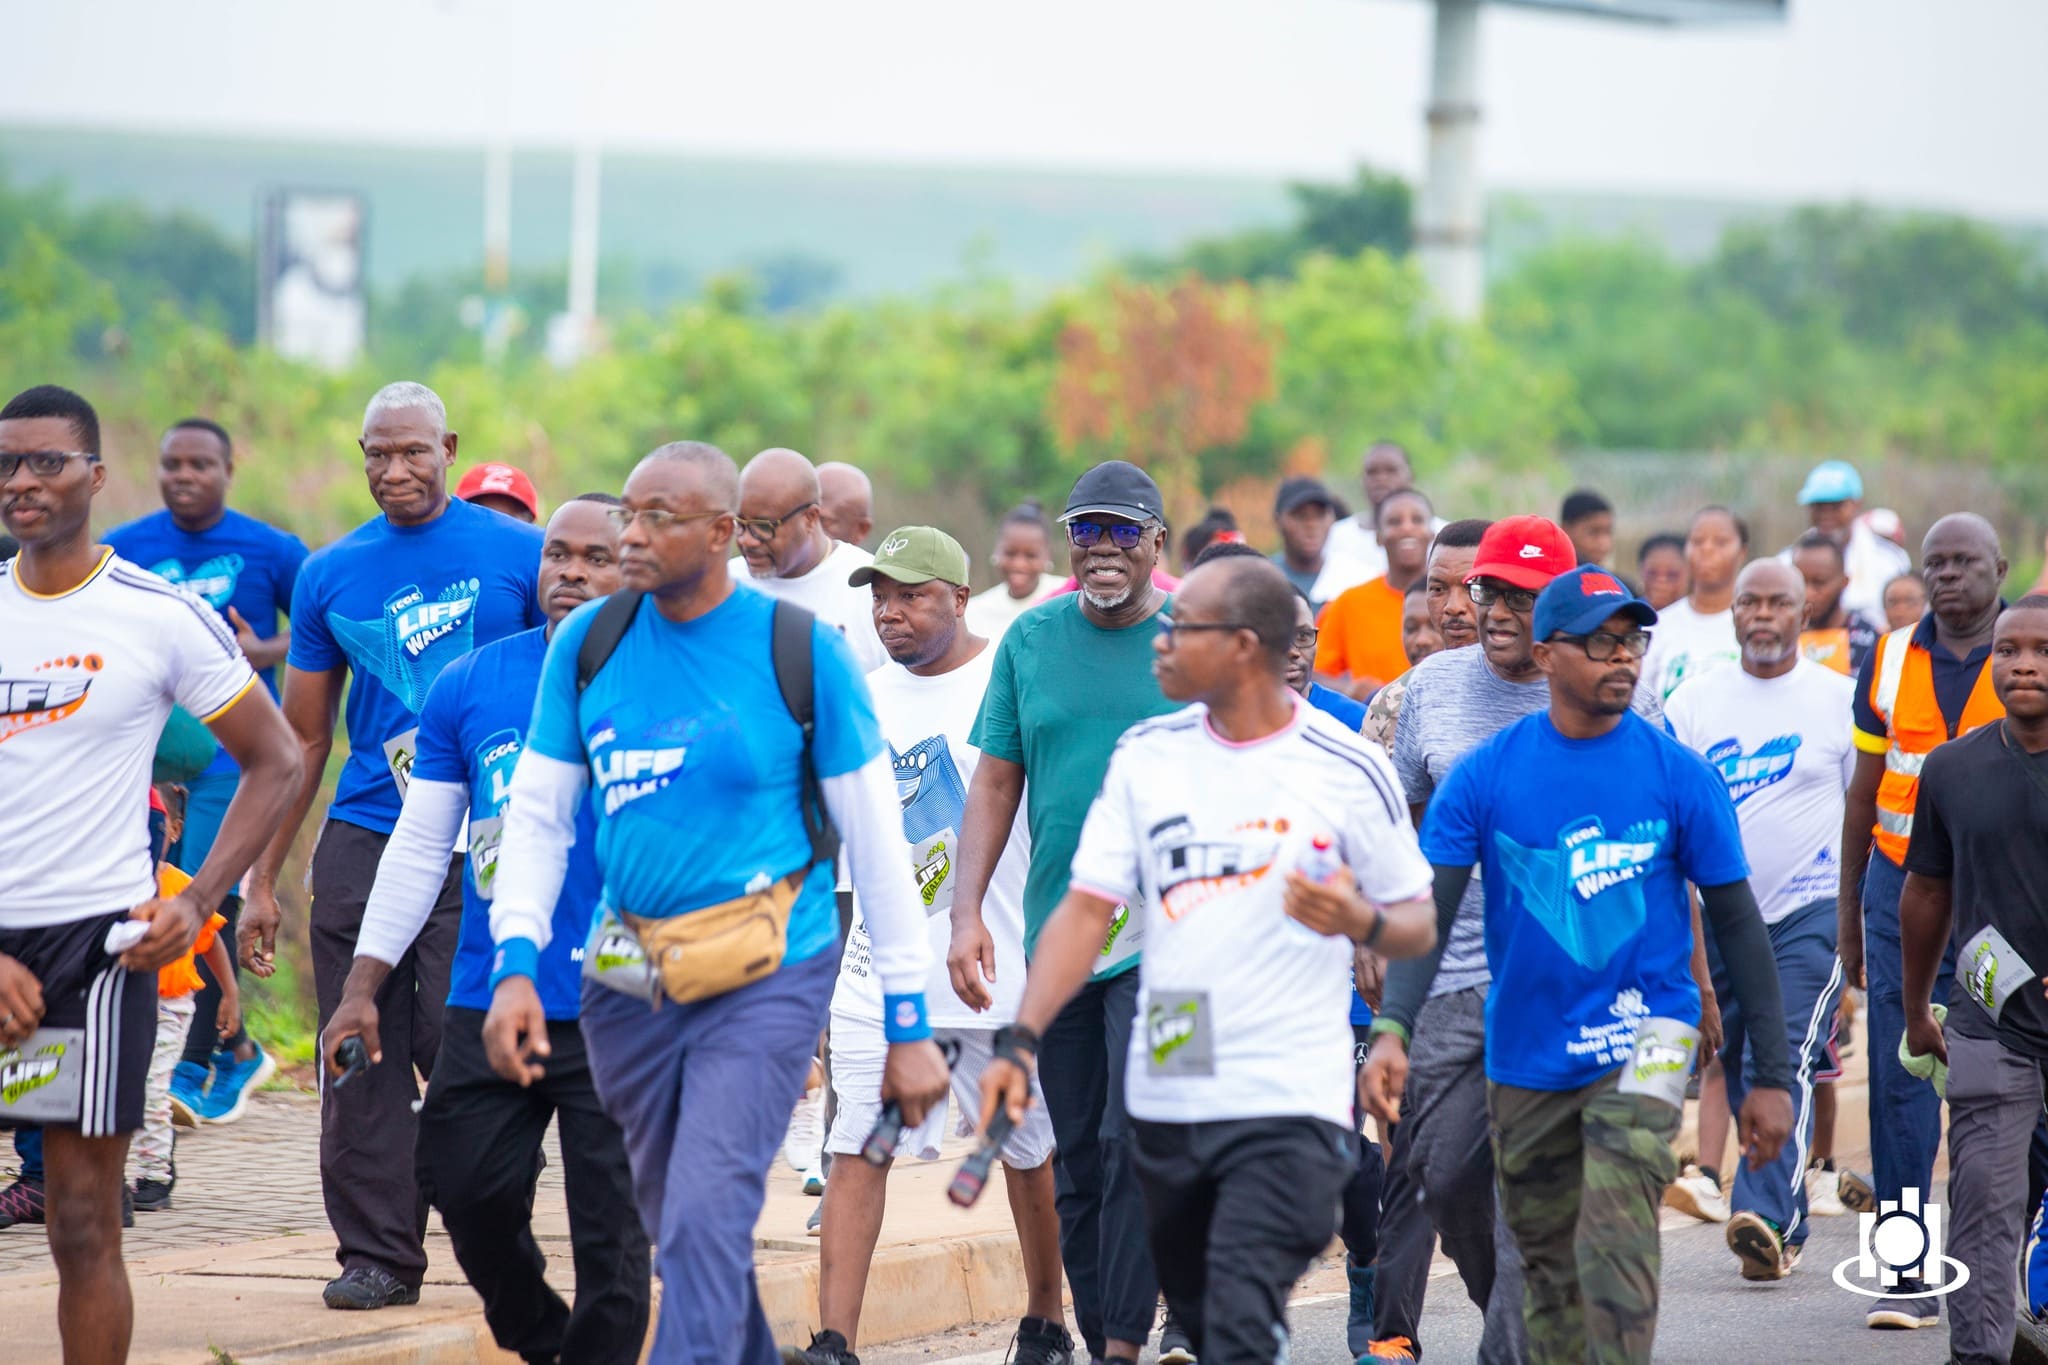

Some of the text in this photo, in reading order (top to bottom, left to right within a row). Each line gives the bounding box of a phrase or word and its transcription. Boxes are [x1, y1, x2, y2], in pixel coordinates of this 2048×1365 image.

[391, 593, 421, 615] ICGC
[398, 596, 473, 640] LIFE
[405, 622, 454, 656] WALK
[484, 741, 519, 768] ICGC
[593, 747, 687, 790] LIFE
[1718, 753, 1792, 784] LIFE
[1159, 844, 1277, 893] LIFE
[1571, 842, 1657, 880] LIFE
[1575, 866, 1636, 900] WALK
[851, 964, 868, 978] Gha
